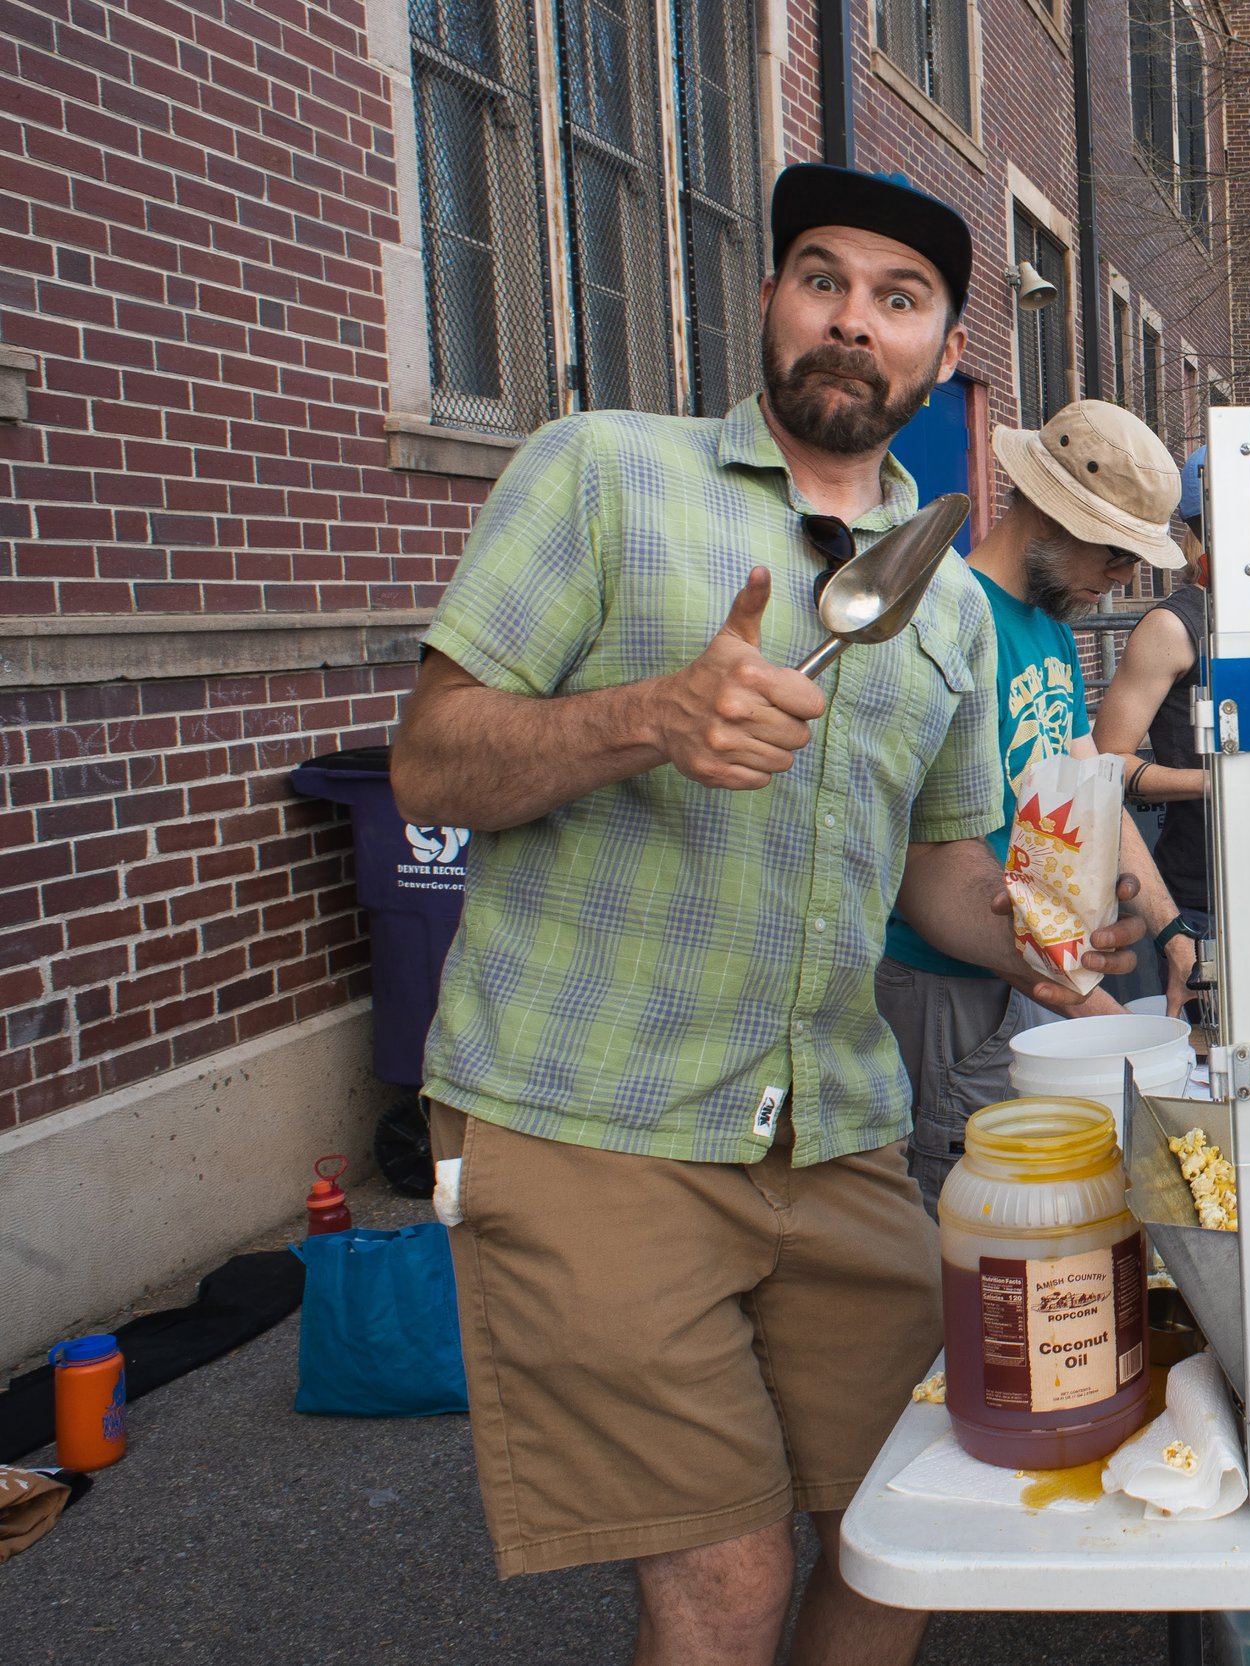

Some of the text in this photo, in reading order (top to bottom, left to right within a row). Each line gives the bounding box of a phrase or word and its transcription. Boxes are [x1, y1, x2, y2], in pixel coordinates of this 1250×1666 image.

[397, 864, 467, 876] DENVER RECYCL
[1036, 1278, 1064, 1291] AMISH
[1067, 1273, 1107, 1283] COUNTRY
[1048, 1306, 1098, 1322] POPCORN
[1039, 1331, 1108, 1354] Coconut
[1064, 1355, 1088, 1369] Oil
